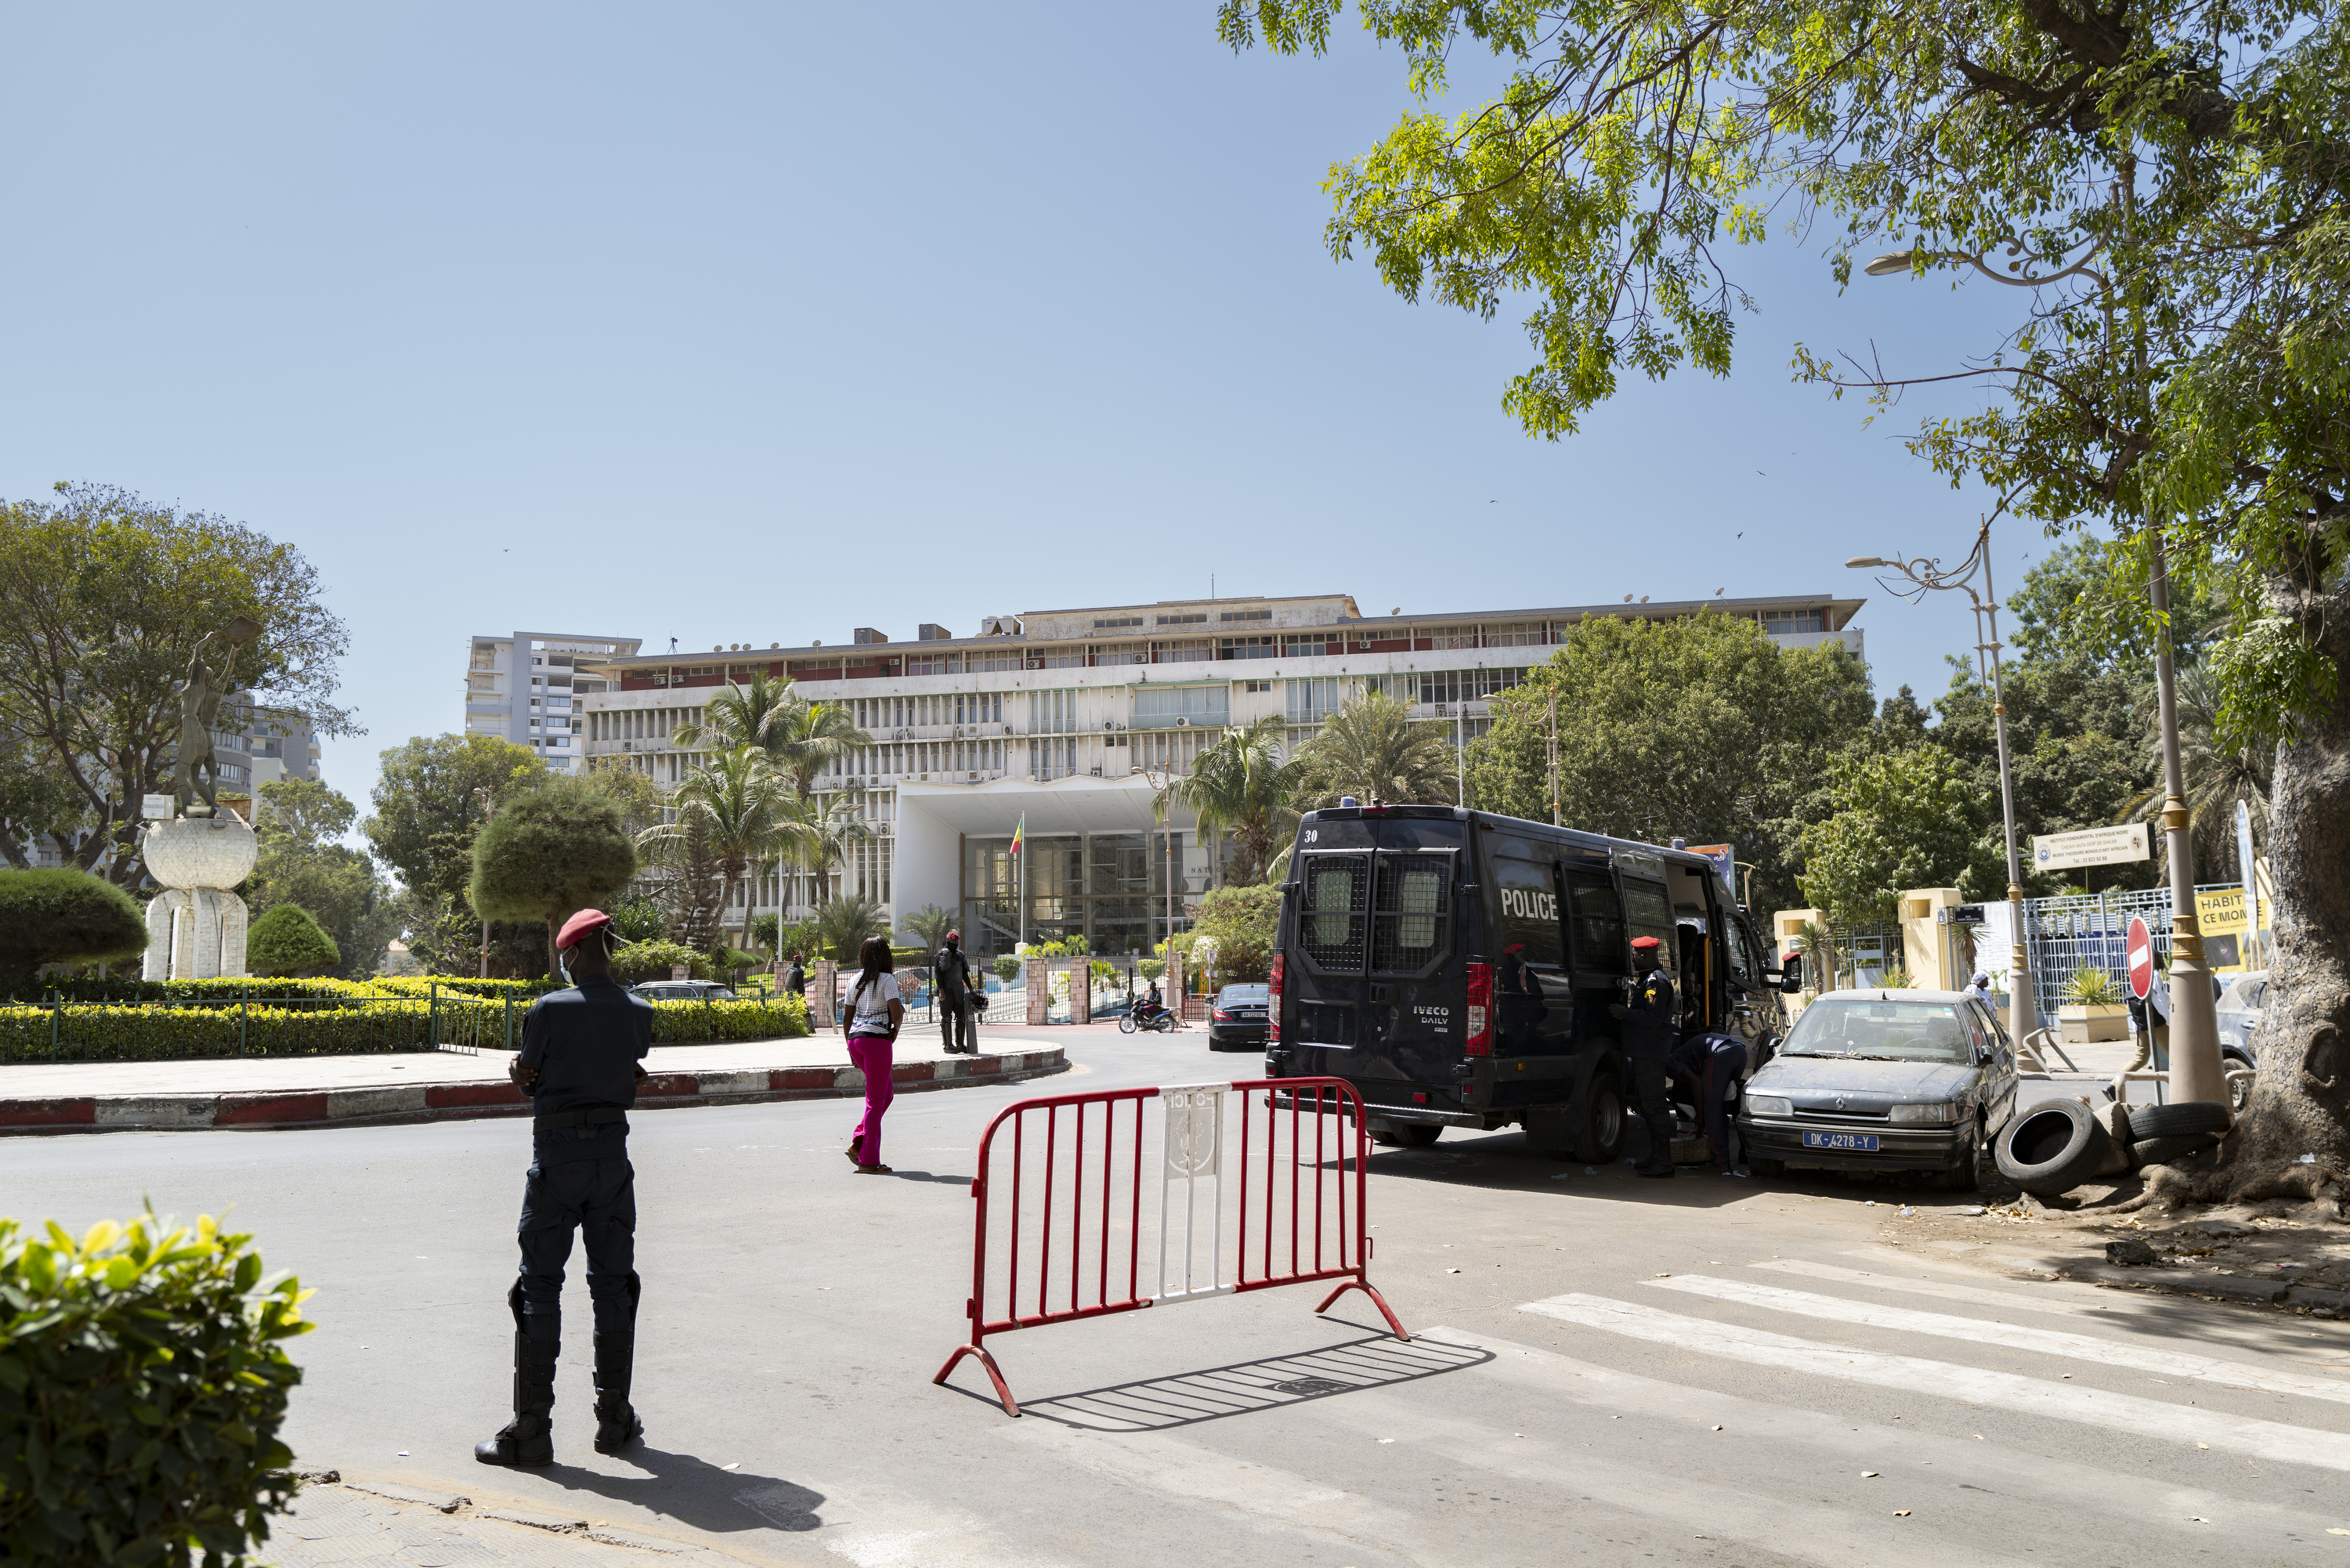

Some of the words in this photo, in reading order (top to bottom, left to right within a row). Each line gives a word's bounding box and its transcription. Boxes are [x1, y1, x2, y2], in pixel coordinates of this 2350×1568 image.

[1304, 829, 1318, 843] 30
[1500, 888, 1559, 921] POLICE
[2201, 894, 2243, 910] HABIT
[2203, 913, 2216, 923] CE
[2218, 906, 2263, 922] MONE
[1413, 1006, 1449, 1016] IVECO
